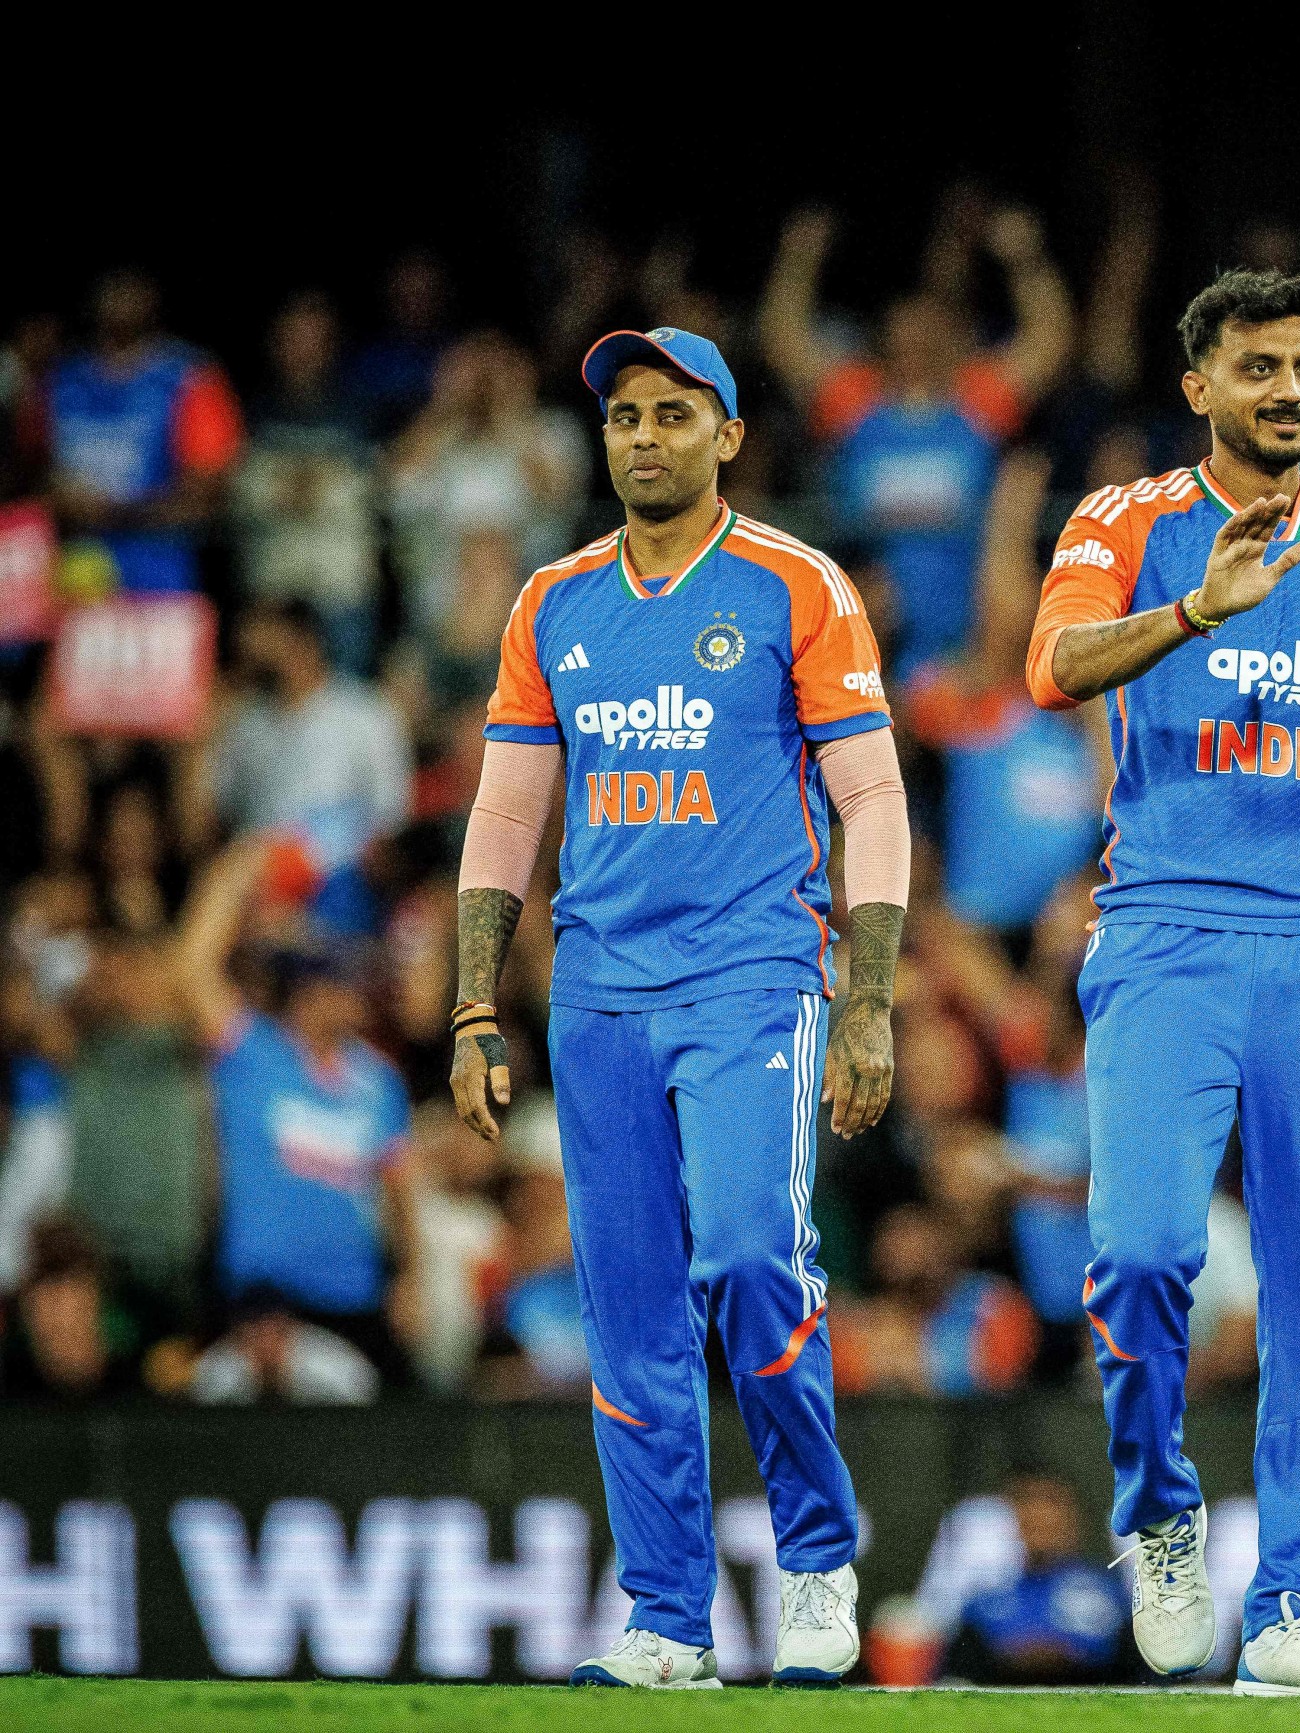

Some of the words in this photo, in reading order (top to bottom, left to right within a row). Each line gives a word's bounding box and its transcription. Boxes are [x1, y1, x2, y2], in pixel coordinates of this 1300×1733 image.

[1052, 539, 1115, 570] pollo
[842, 662, 882, 697] apol
[575, 685, 714, 745] apollo
[618, 730, 710, 751] TYRES
[587, 769, 718, 826] INDIA
